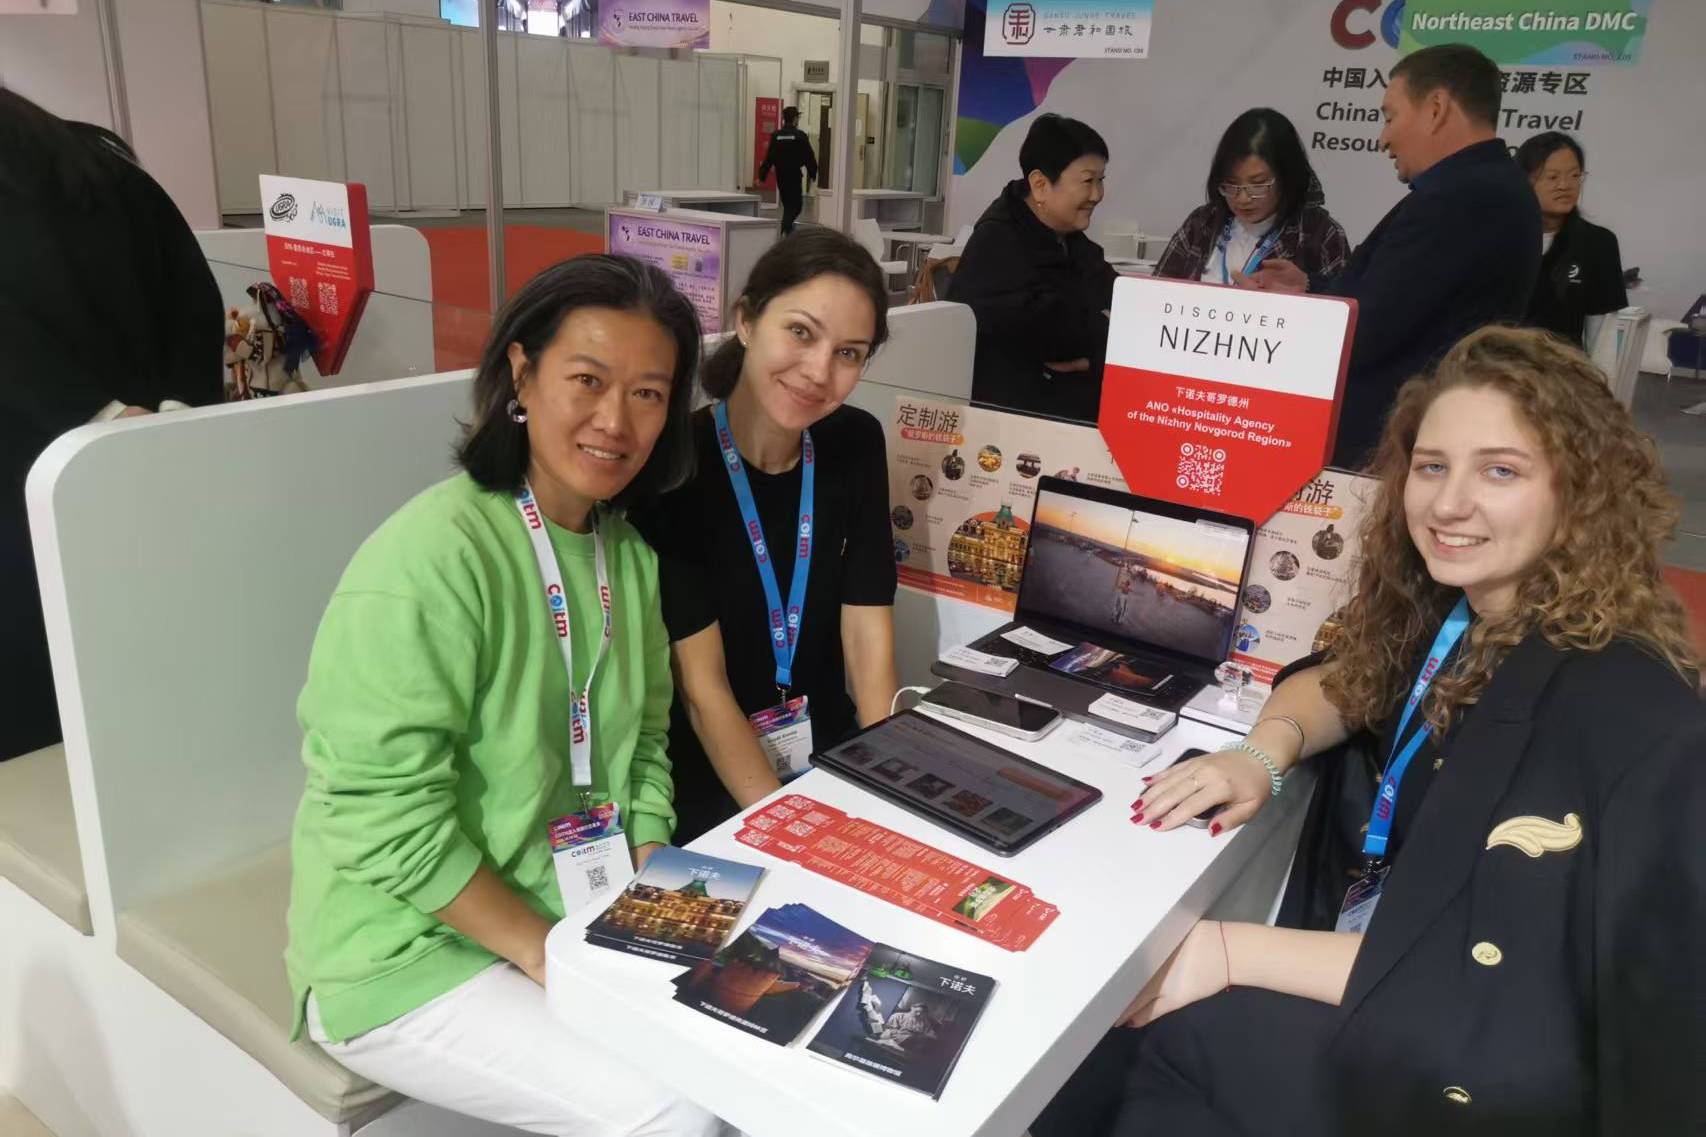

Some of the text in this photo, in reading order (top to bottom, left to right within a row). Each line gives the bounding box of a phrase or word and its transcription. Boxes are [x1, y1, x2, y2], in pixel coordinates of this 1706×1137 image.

[629, 13, 699, 23] EAST CHINA TRAVEL
[1412, 12, 1637, 31] Northeast China DMC
[1316, 102, 1583, 131] China Travel
[1312, 131, 1380, 152] Resou
[638, 226, 710, 245] EAST CHINA TRAVEL
[1164, 303, 1286, 329] DISCOVER
[1159, 324, 1282, 364] NIZHNY
[1175, 386, 1249, 409] 下诺夫哥罗德州
[896, 403, 960, 433] 定制游
[1146, 401, 1275, 432] ANO «Hospitality Agency
[1127, 410, 1292, 449] of the Nizhny Novgorod Region»
[938, 976, 977, 996] 下诺夫
